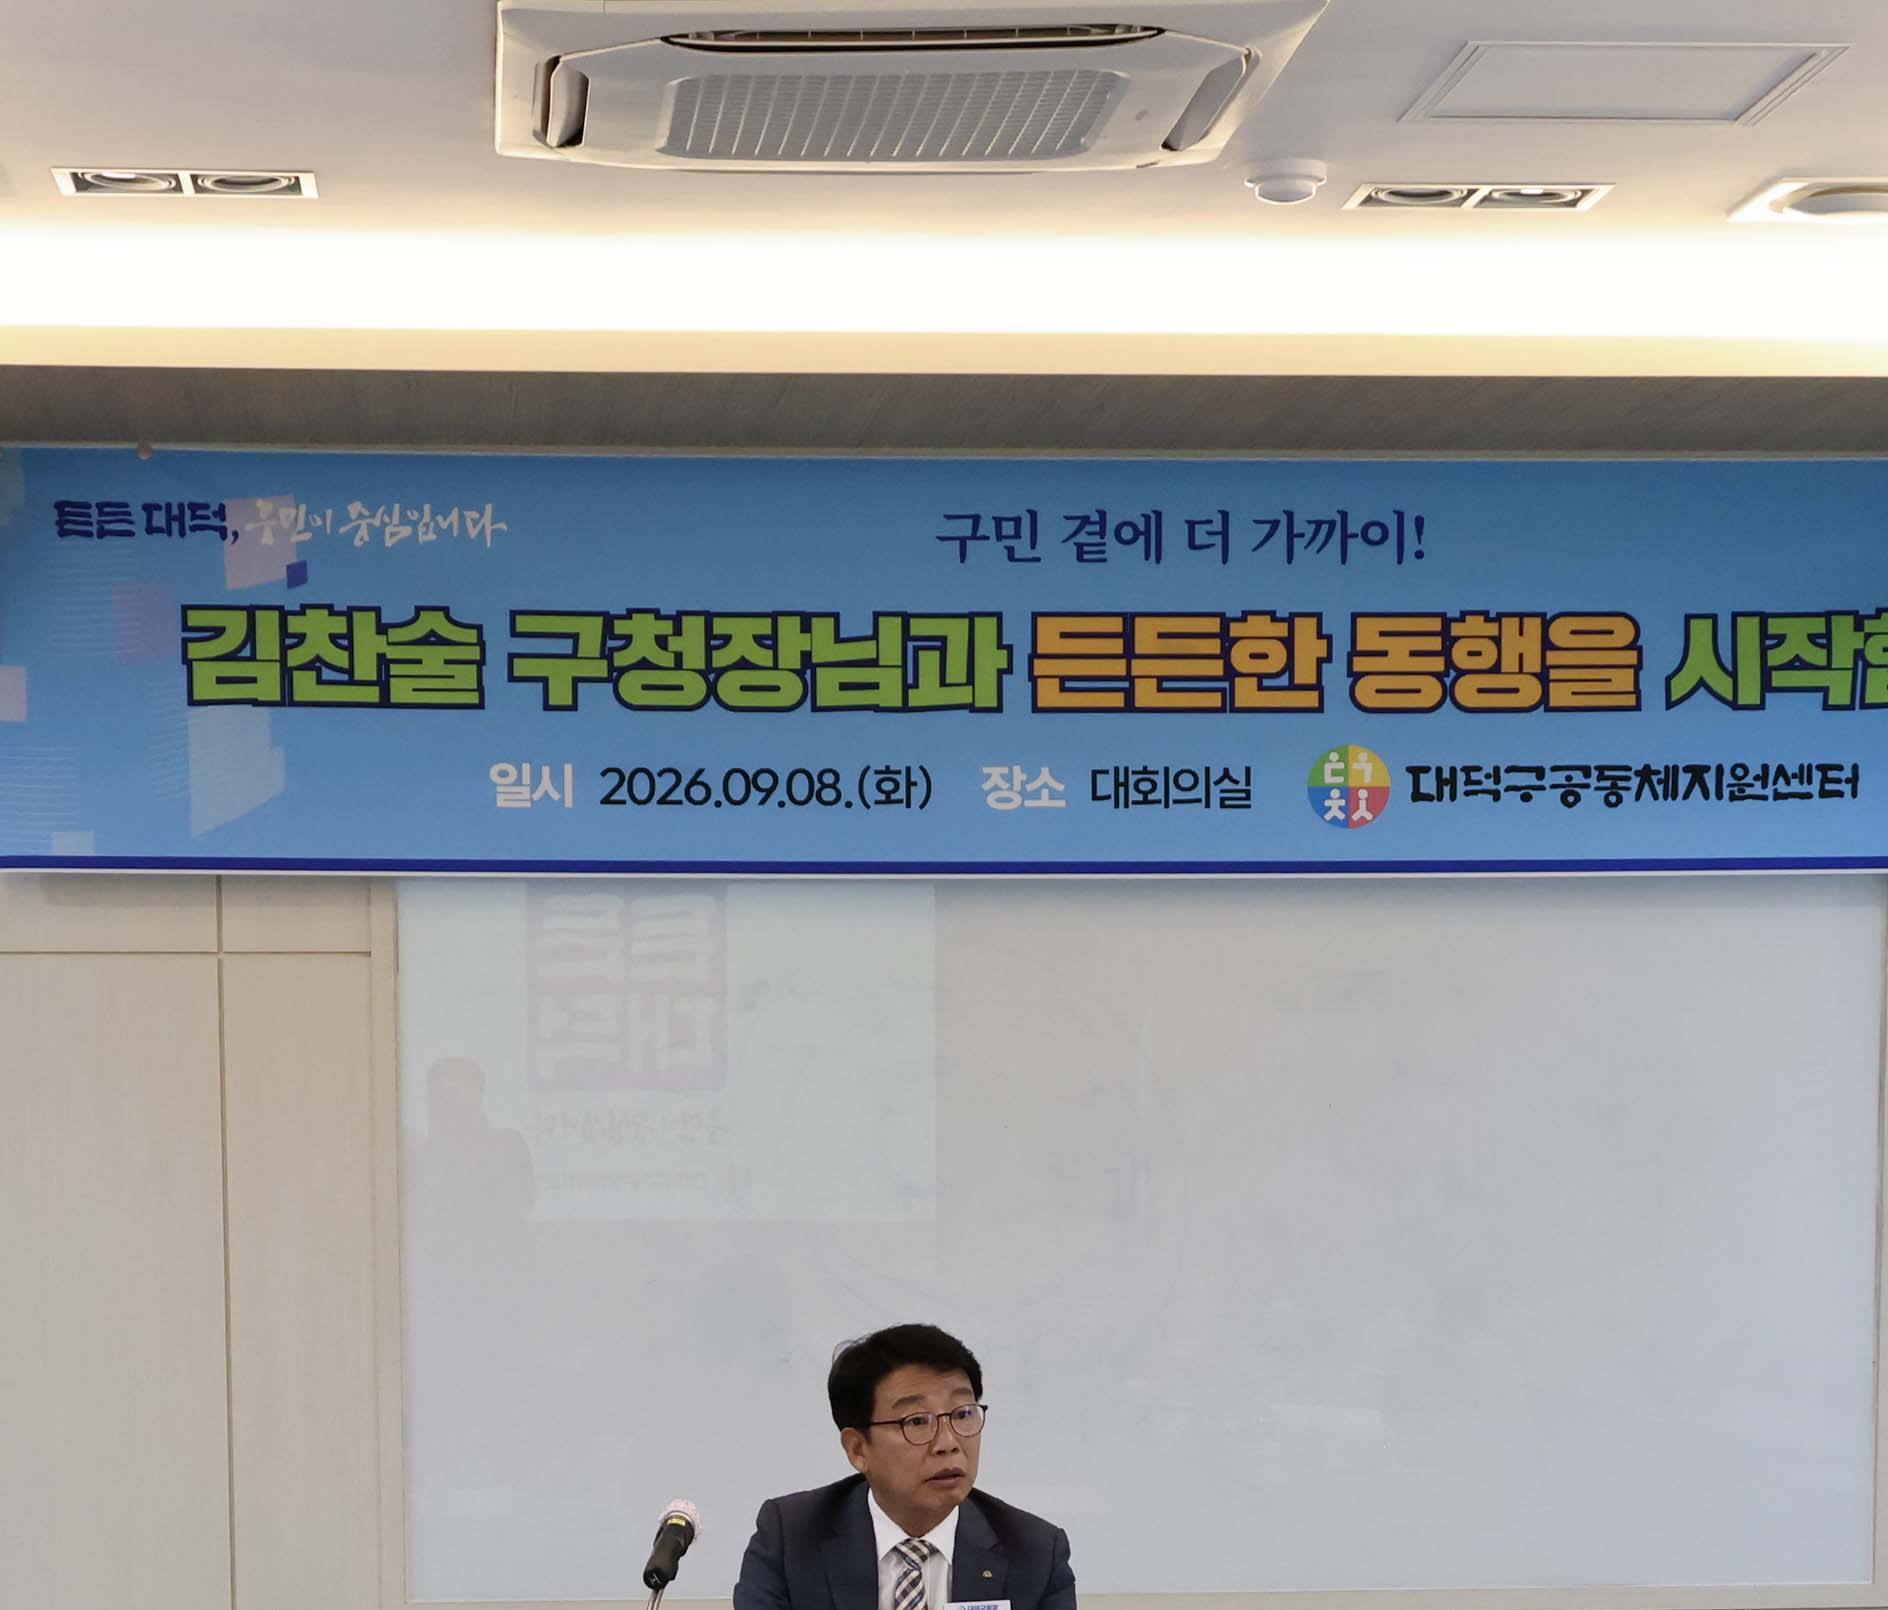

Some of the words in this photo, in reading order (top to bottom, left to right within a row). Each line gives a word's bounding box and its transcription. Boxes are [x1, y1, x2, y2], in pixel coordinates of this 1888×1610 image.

[141, 501, 239, 546] 대덕,
[934, 511, 1042, 566] 구민
[1060, 509, 1164, 566] 곁에
[1184, 510, 1232, 564] 더
[1249, 508, 1428, 566] 가까이!
[180, 604, 485, 708] 김찬술
[508, 608, 1013, 713] 구청장님과
[1029, 610, 1332, 713] 든든한
[1347, 610, 1642, 713] 동행을
[488, 761, 574, 810] 일시
[598, 762, 935, 812] 2026.09.08.(화)
[980, 762, 1067, 812] 장소
[1090, 762, 1254, 812] 대회의실
[1405, 763, 1862, 808] 대덕구공동체지원센터
